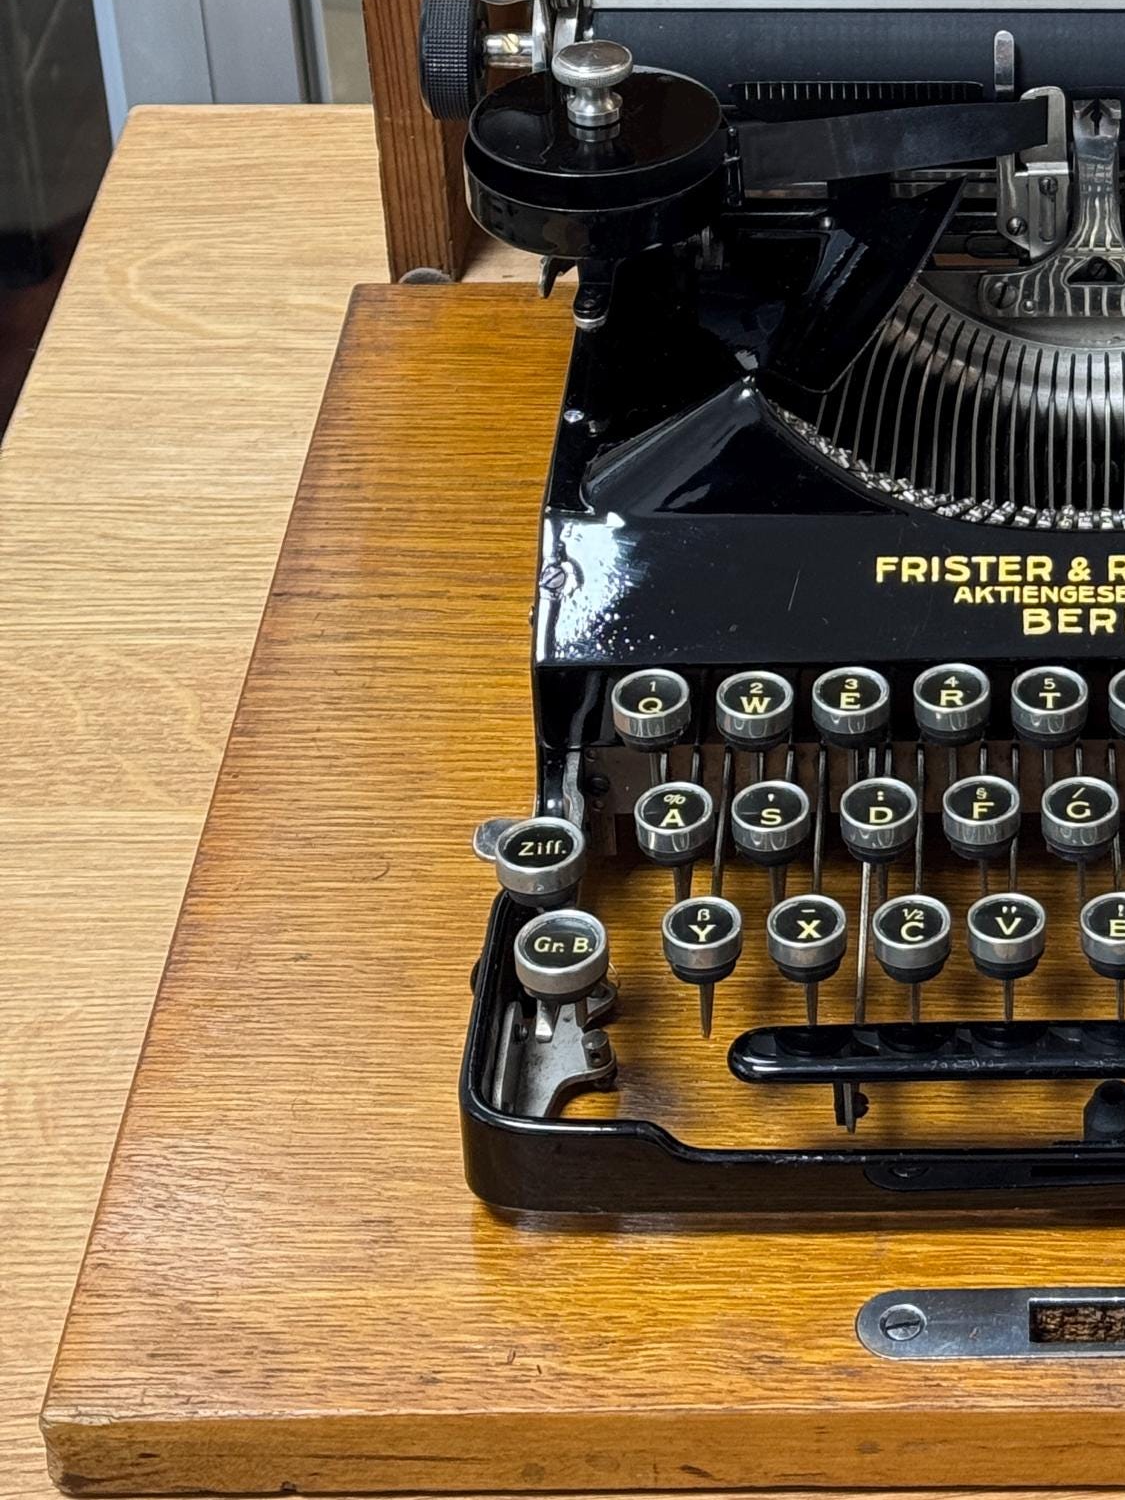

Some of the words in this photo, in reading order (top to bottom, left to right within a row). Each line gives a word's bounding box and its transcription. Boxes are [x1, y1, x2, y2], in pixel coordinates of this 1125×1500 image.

[876, 555, 1053, 583] FRISTER
[1067, 556, 1092, 583] &
[749, 682, 764, 694] 2
[844, 678, 859, 690] 3
[943, 675, 959, 688] 4
[1043, 677, 1056, 690] 5
[638, 697, 663, 713] Q
[739, 696, 771, 714] W
[839, 692, 861, 710] E
[939, 690, 964, 706] R
[1038, 692, 1061, 709] T
[661, 790, 687, 805] %
[975, 787, 988, 800] §
[660, 808, 686, 827] A
[759, 808, 783, 826] S
[868, 806, 894, 824] D
[972, 802, 995, 819] F
[1066, 800, 1091, 819] G
[518, 840, 566, 856] Ziff.
[1117, 904, 1125, 917] !
[688, 924, 716, 942] Y
[796, 919, 822, 939] X
[900, 921, 925, 942] C
[995, 916, 1022, 936] V
[534, 936, 565, 953] Gr.
[572, 937, 593, 953] B.
